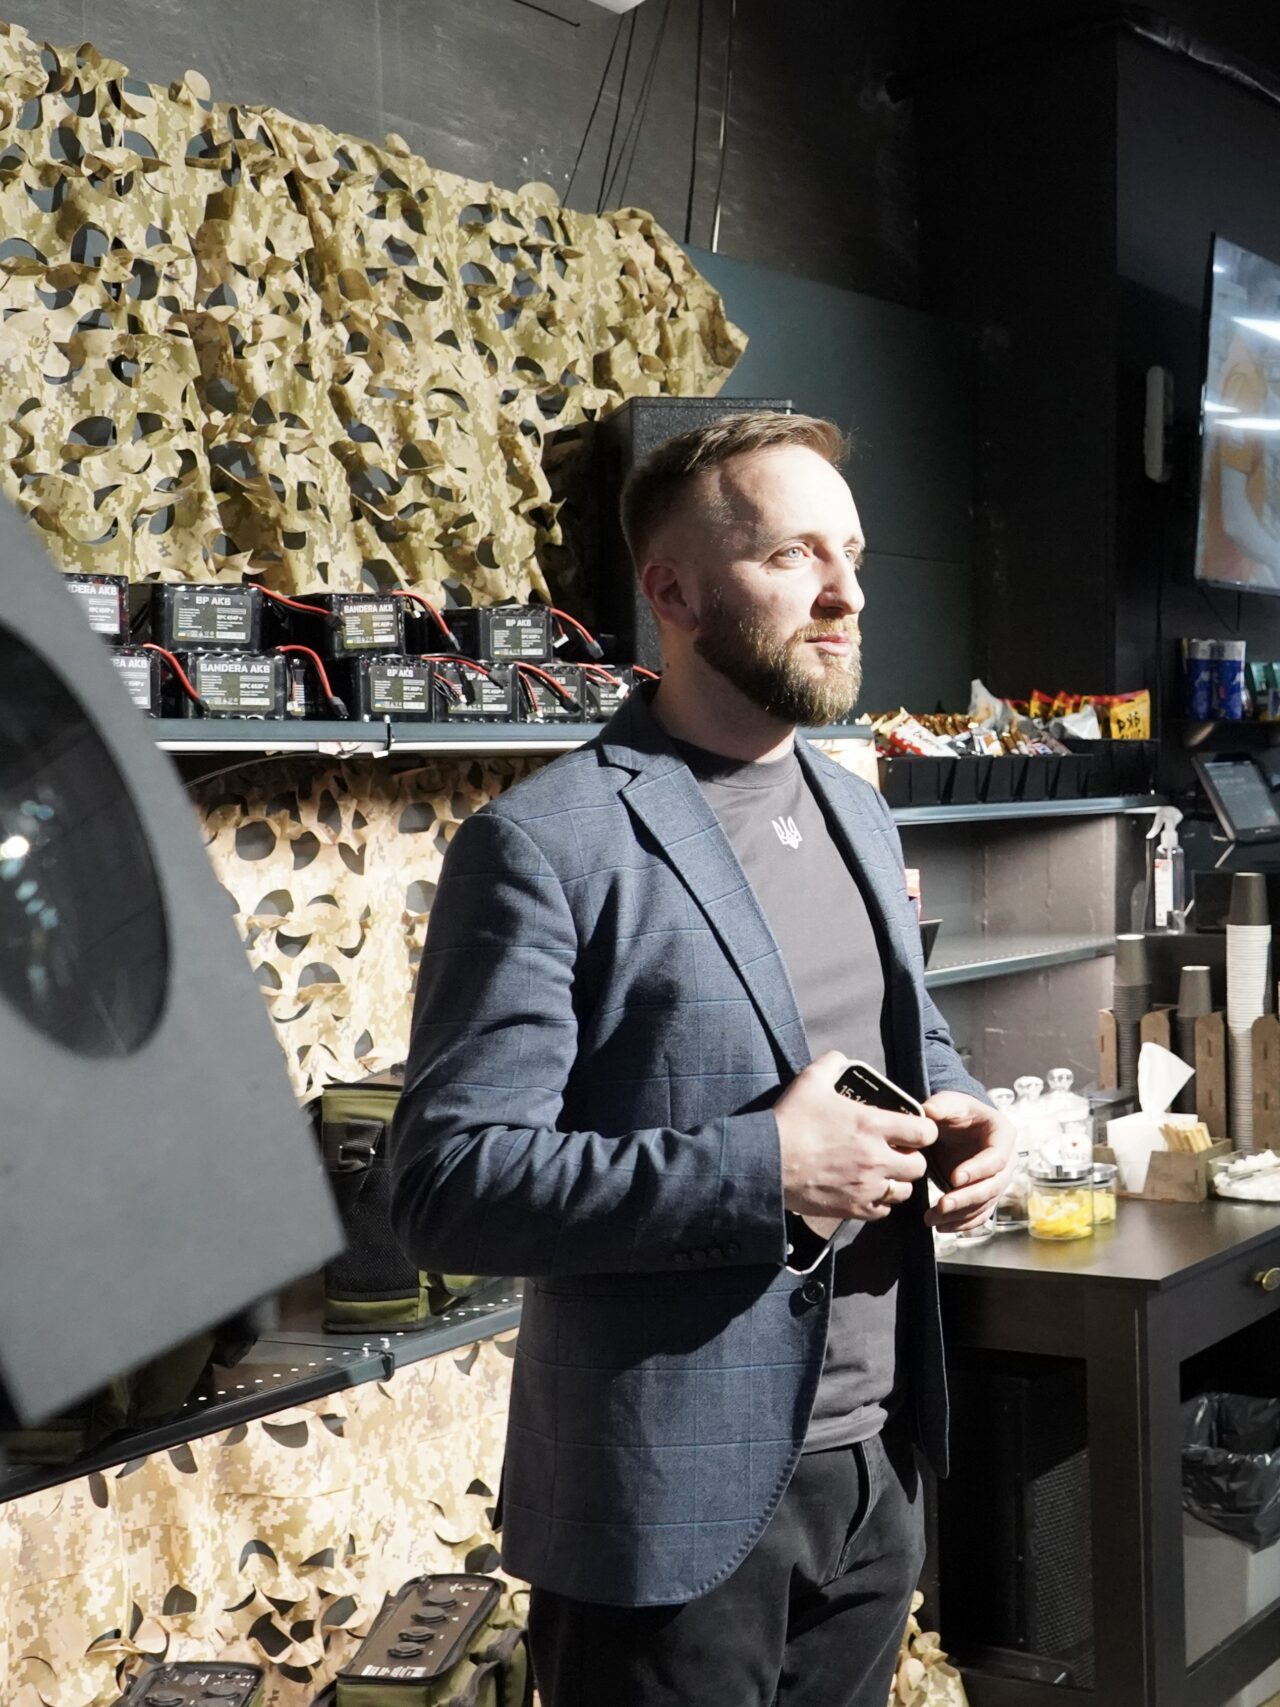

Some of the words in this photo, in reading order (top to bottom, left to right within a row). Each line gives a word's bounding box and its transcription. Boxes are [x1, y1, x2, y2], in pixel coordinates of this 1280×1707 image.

[211, 597, 231, 606] AKB
[200, 663, 248, 673] BANDERA
[250, 664, 270, 674] AKB
